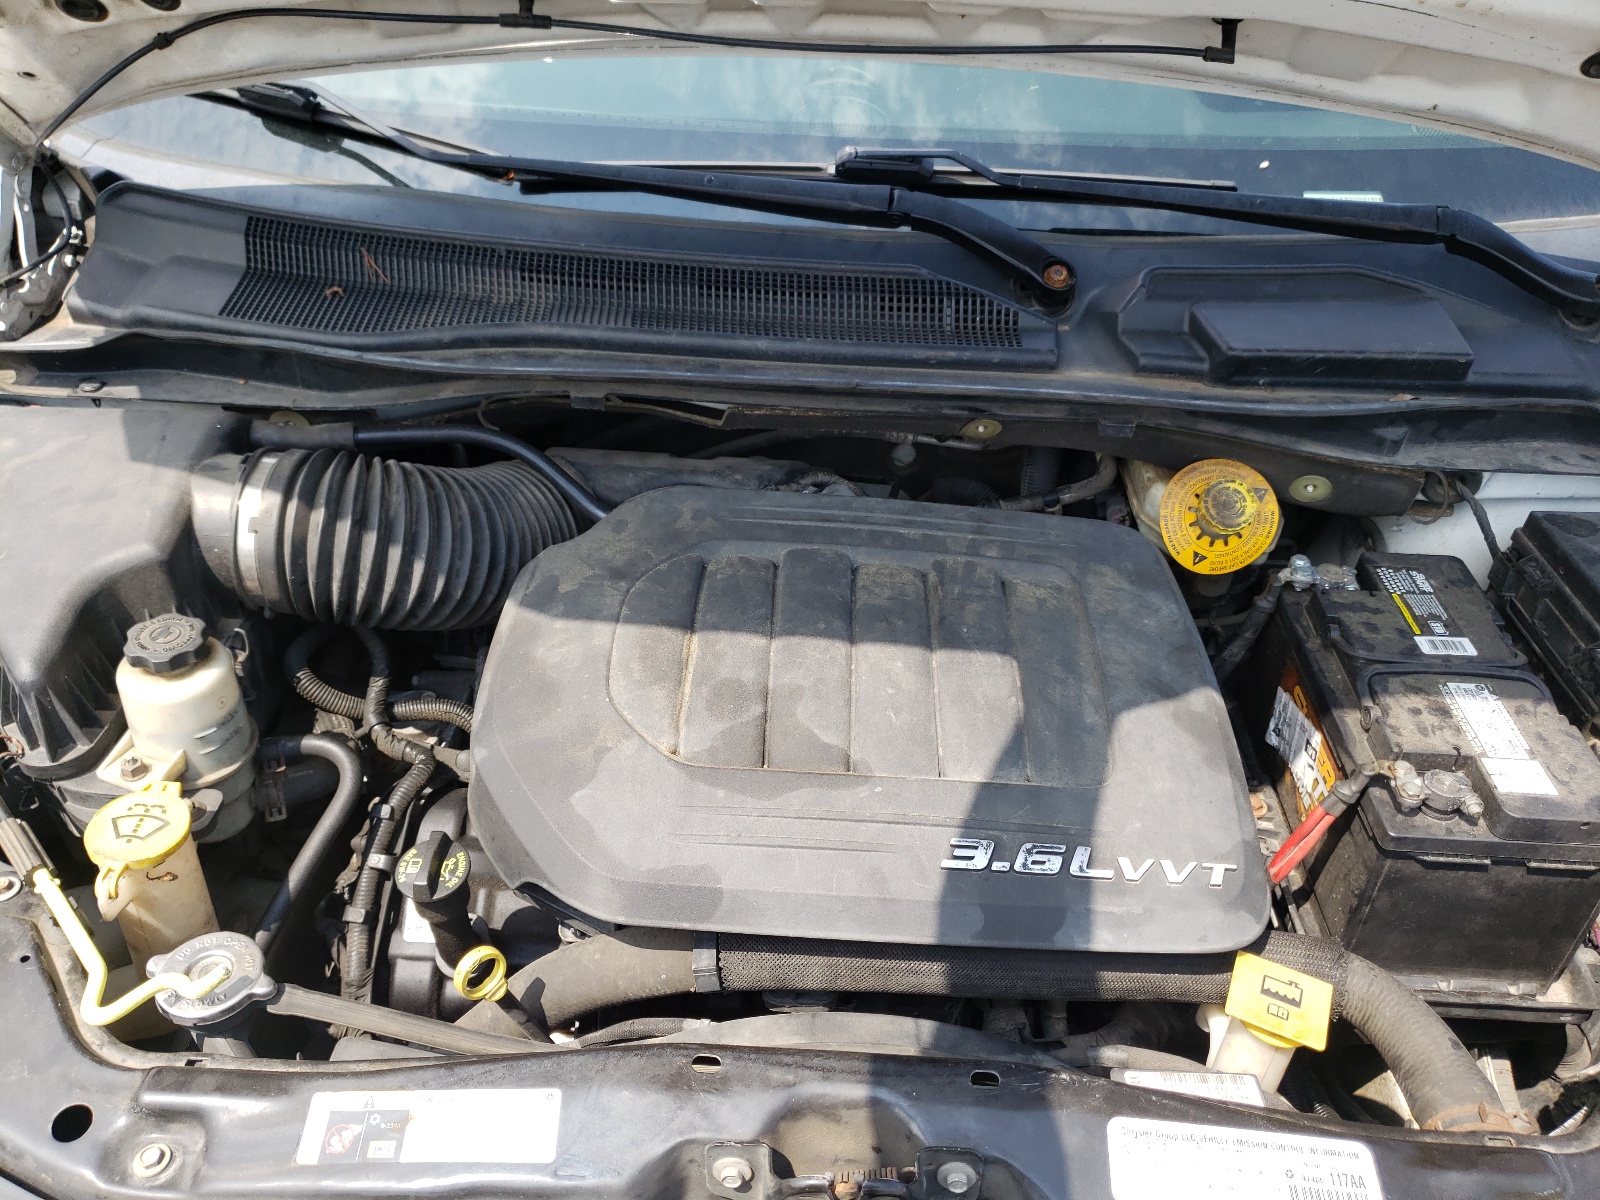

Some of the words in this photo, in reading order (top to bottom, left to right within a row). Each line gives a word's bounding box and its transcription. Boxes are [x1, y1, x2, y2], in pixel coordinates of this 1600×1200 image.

[455, 852, 467, 878] ENGINE
[445, 877, 458, 888] OIL
[176, 947, 192, 961] DO
[195, 938, 218, 949] NOT
[224, 937, 246, 954] OPEN
[244, 954, 255, 971] HOT
[182, 994, 228, 1008] SLOWLY
[1121, 1126, 1152, 1140] Chrysler
[1155, 1130, 1178, 1142] Group
[1232, 1138, 1269, 1150] EMISSION
[1330, 1172, 1367, 1189] 117AA
